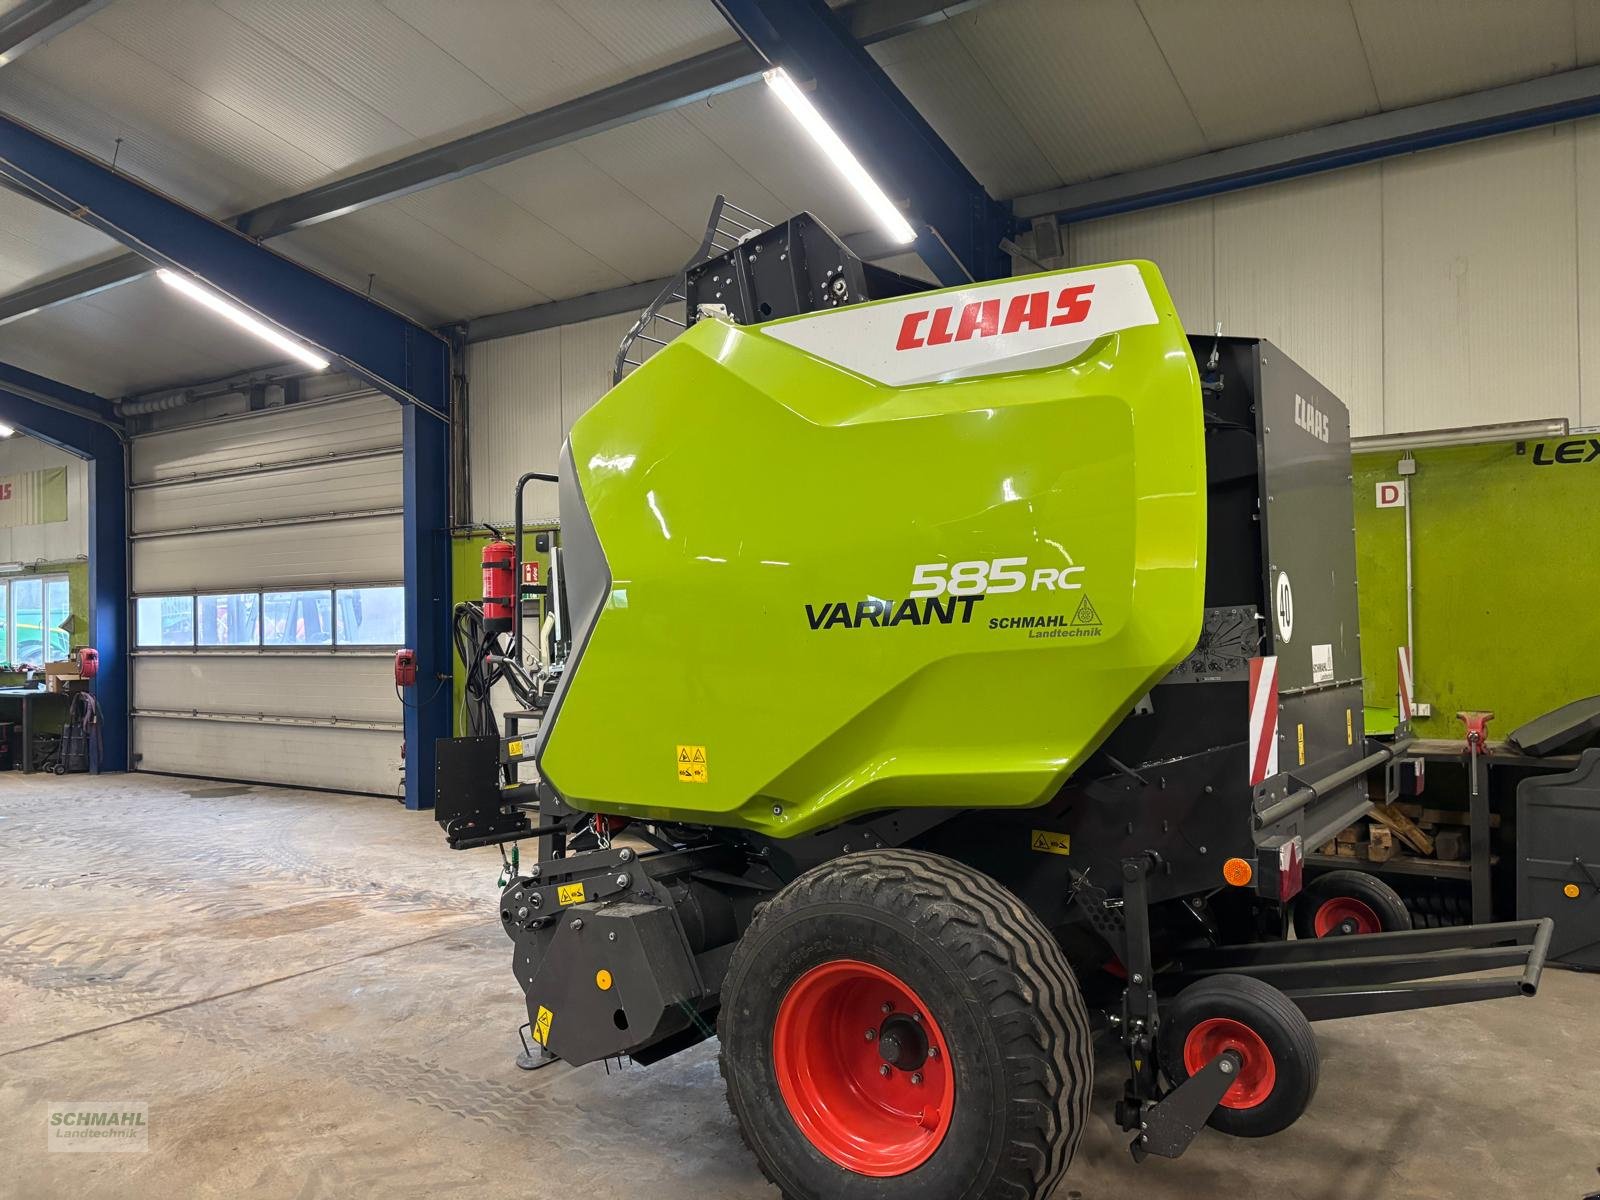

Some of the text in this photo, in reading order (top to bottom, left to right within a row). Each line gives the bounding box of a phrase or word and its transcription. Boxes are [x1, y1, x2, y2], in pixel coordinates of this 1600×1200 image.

[896, 284, 1095, 351] CLAAS
[1295, 393, 1329, 444] CLAAS
[1381, 485, 1399, 505] D
[909, 557, 1086, 599] 585 RC
[804, 594, 985, 630] VARIANT
[988, 615, 1068, 630] SCHMAHL
[1280, 584, 1291, 628] 40
[1028, 627, 1102, 640] Landtechnik
